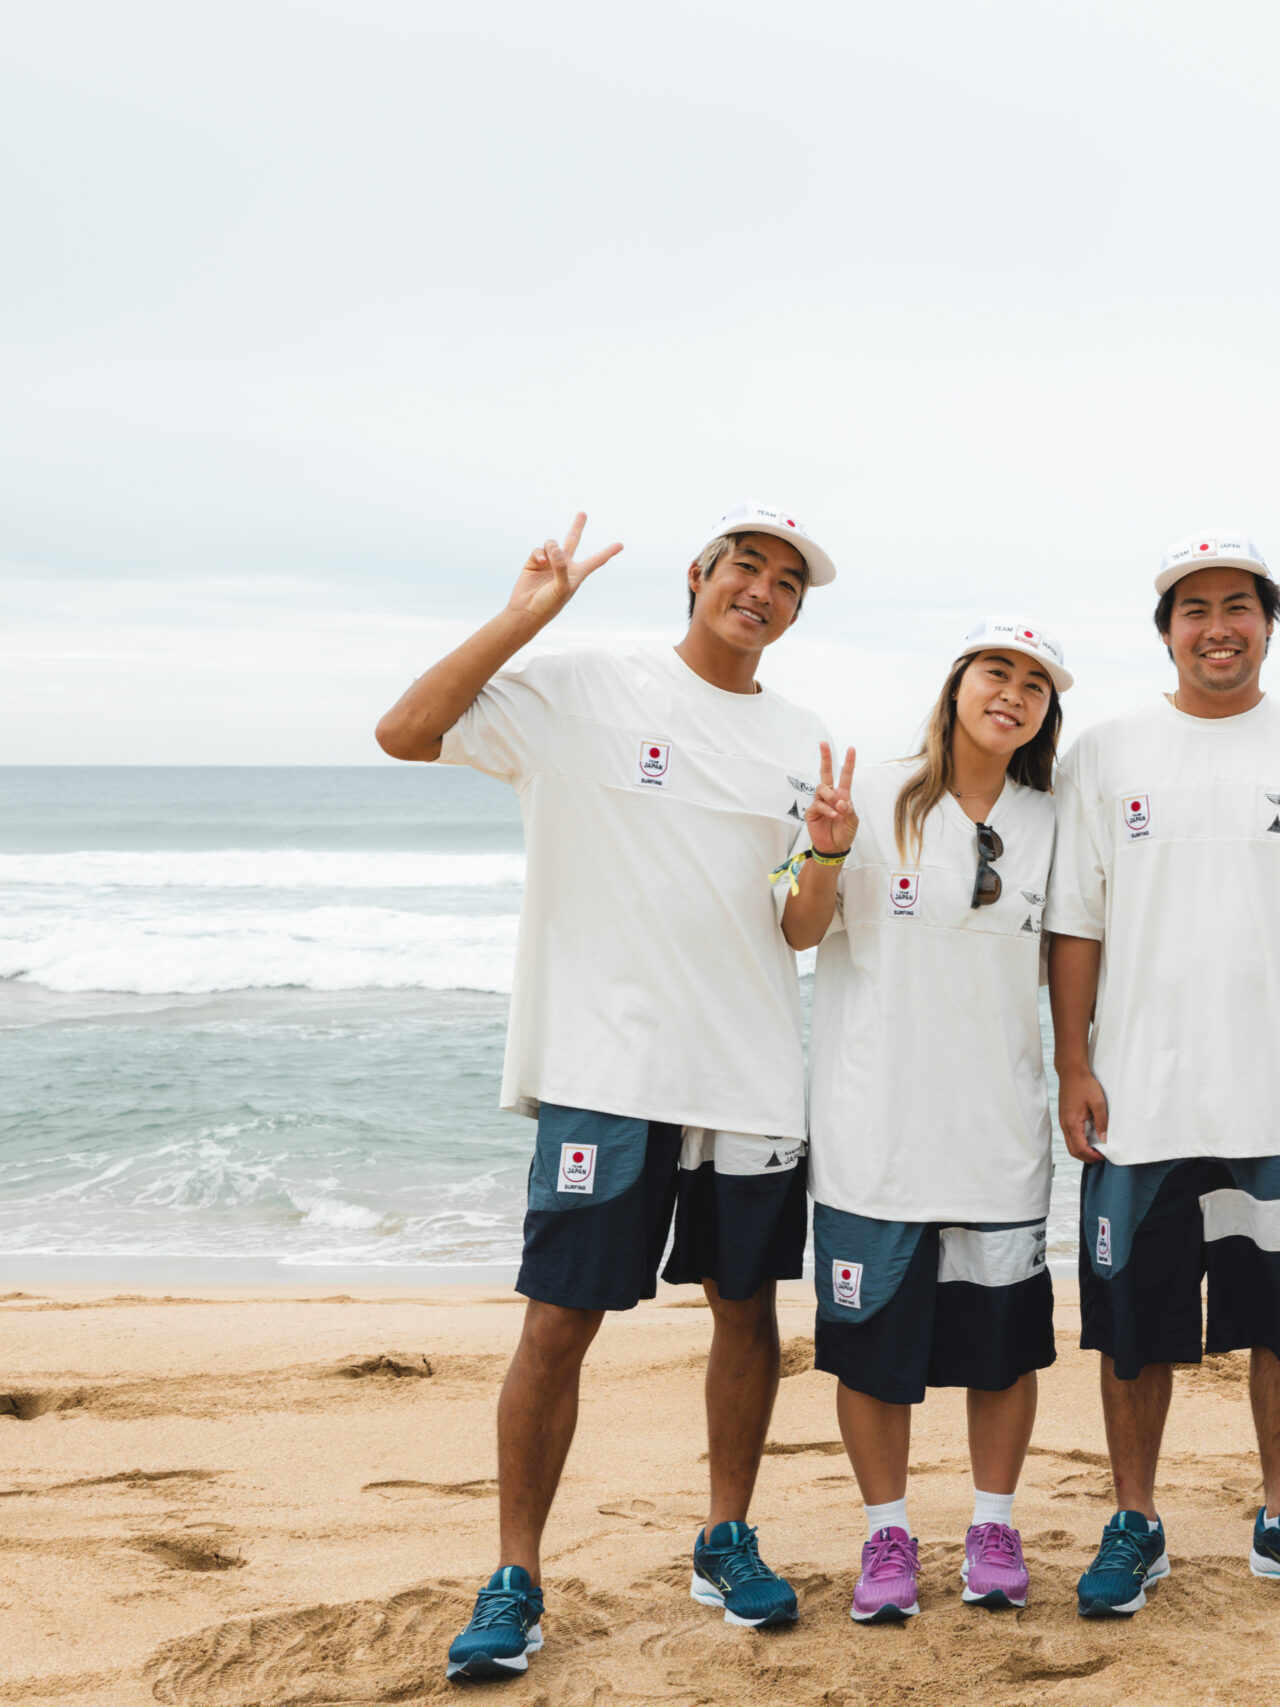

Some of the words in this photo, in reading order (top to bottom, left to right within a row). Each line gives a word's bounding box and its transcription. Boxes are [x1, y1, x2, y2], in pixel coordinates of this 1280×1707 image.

[757, 510, 777, 518] TEAM
[1171, 550, 1189, 560] TEAM
[644, 762, 663, 770] JAPAN
[1129, 816, 1146, 824] JAPAN
